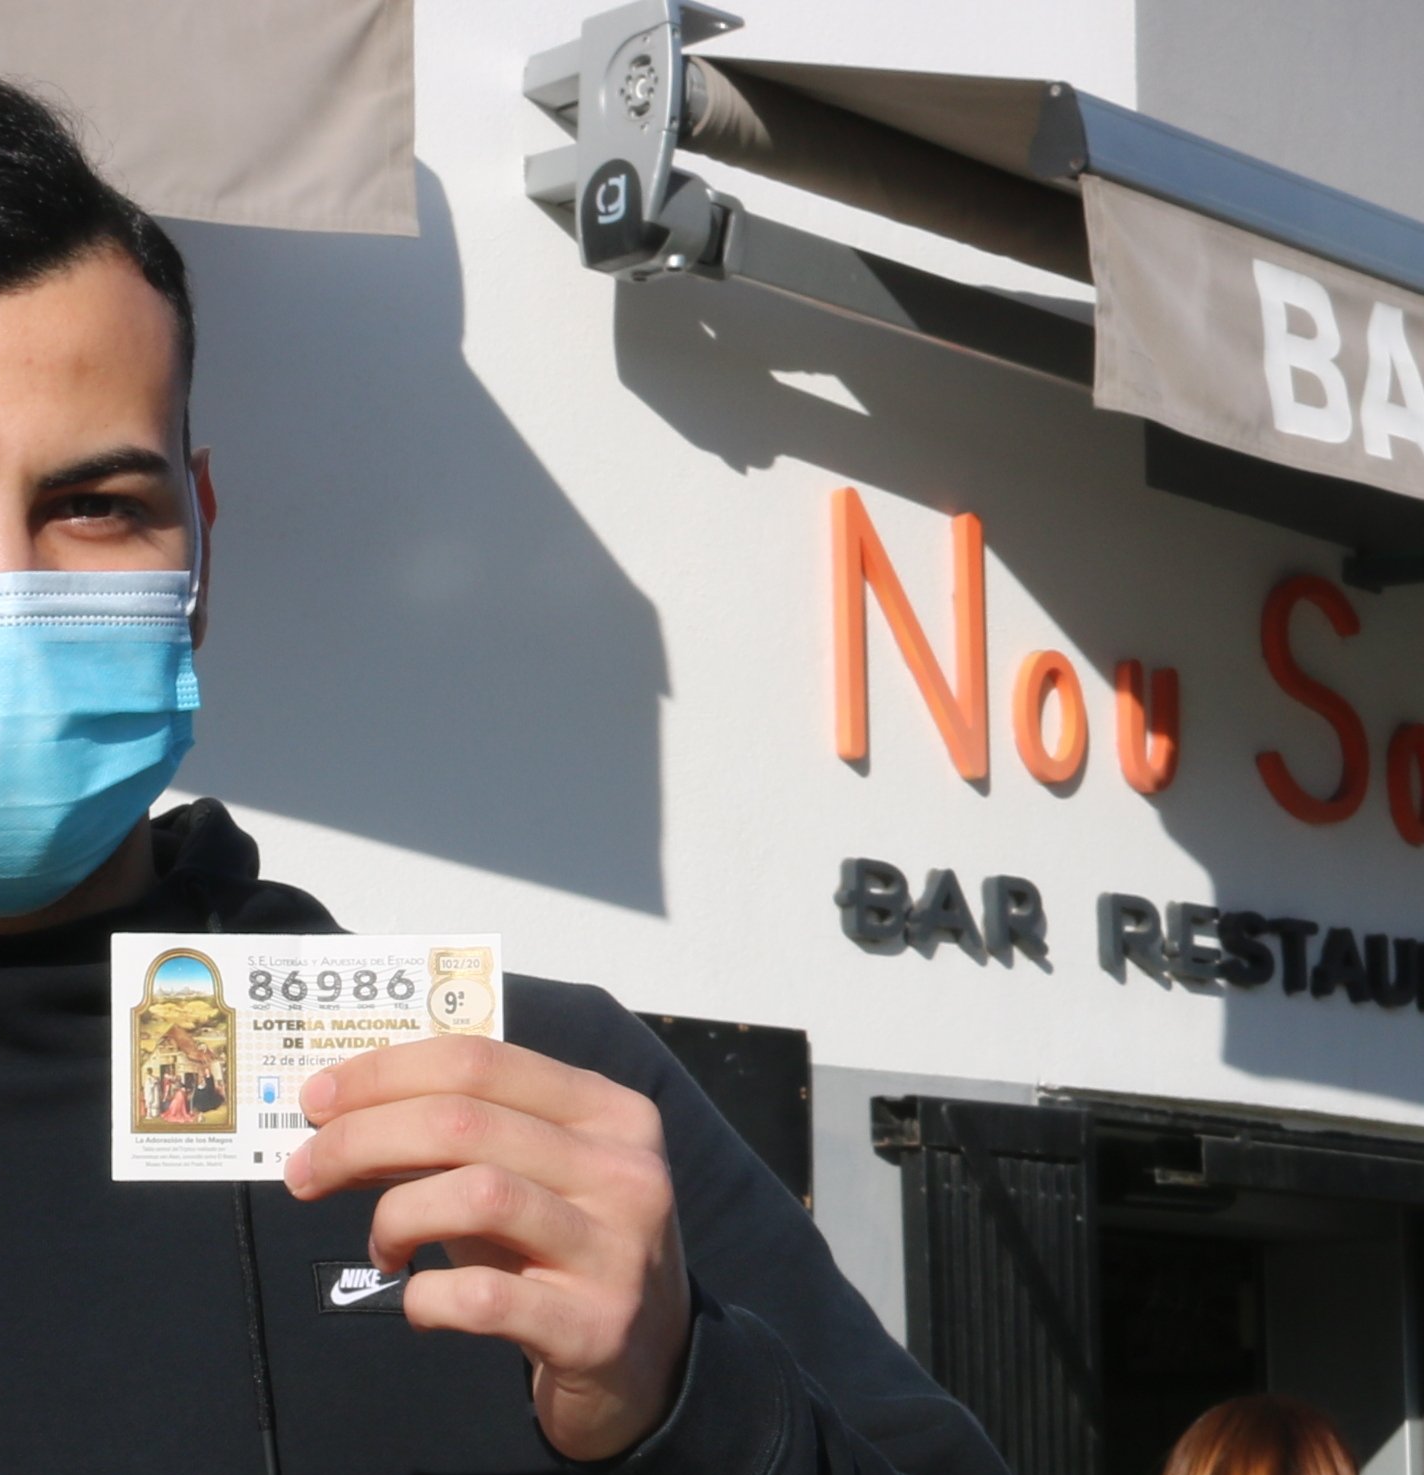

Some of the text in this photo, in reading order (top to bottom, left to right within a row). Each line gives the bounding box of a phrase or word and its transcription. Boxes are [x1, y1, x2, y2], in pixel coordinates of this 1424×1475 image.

[831, 486, 1181, 794] Nou
[834, 857, 1048, 968] BAR
[441, 958, 480, 970] 102/20
[248, 969, 415, 1002] 86986
[253, 1018, 420, 1031] LOTERÍA NACIONAL
[283, 1036, 391, 1049] DE NAVIDAD
[263, 1055, 276, 1066] 22
[280, 1055, 295, 1066] de
[340, 1268, 381, 1288] NIKE
